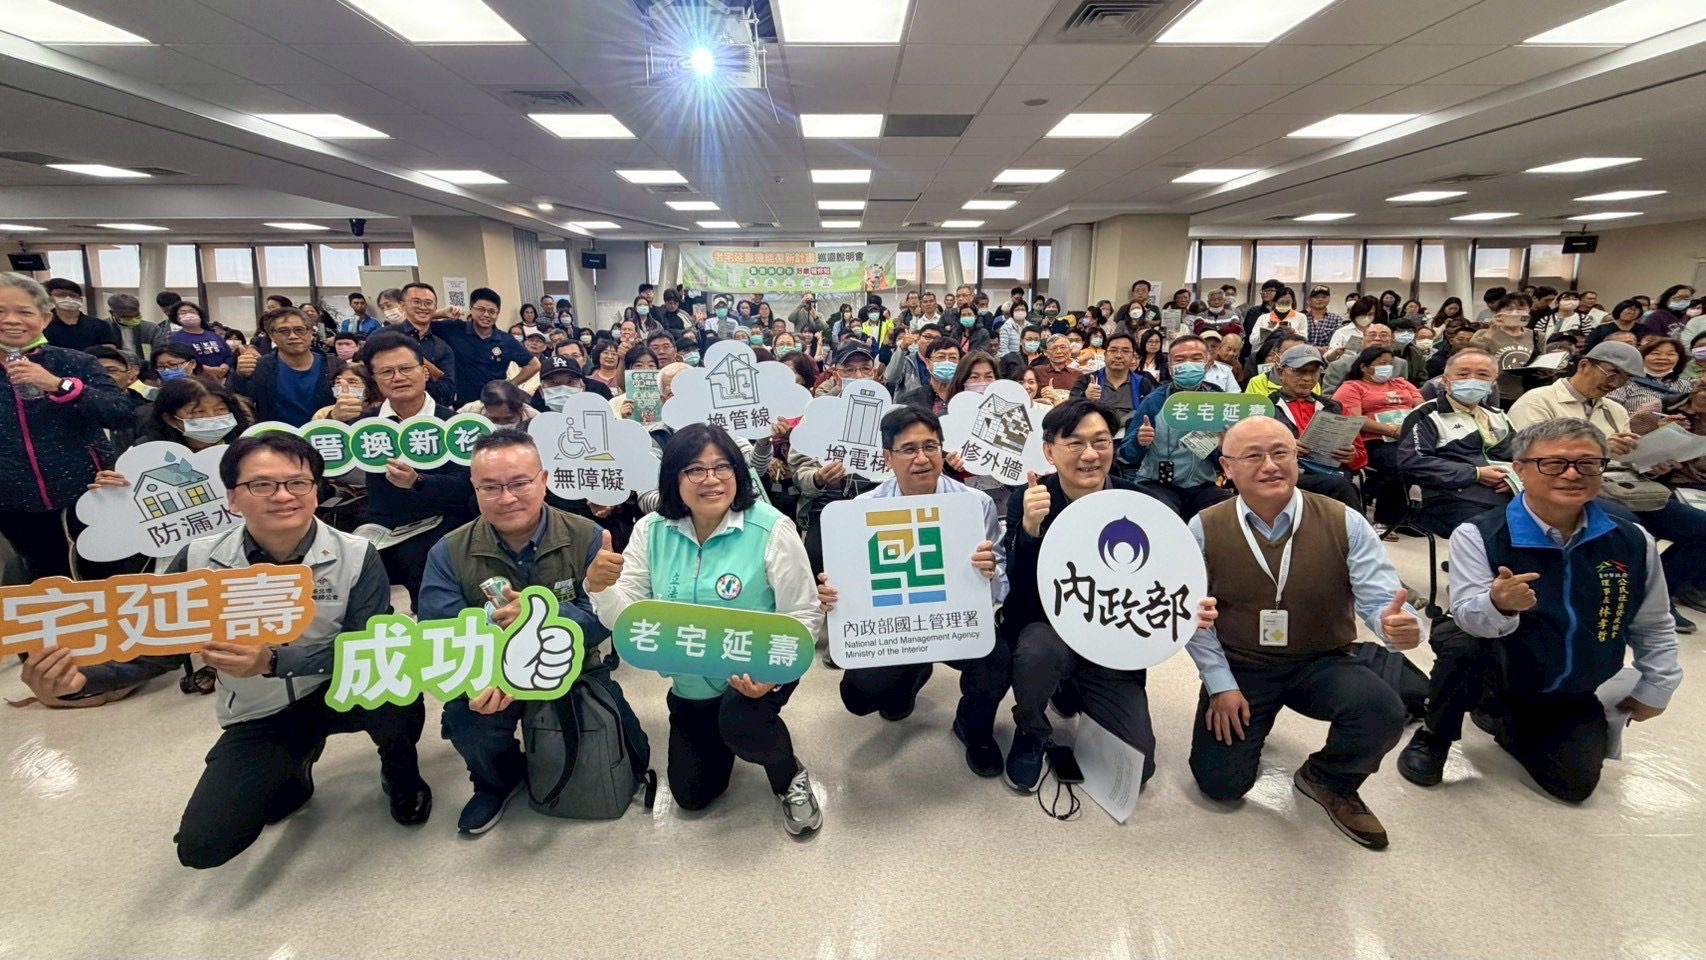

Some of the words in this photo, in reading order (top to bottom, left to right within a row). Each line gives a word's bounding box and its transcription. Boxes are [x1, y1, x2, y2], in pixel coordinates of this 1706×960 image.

[553, 357, 567, 367] LA
[553, 467, 625, 491] 無障礙
[960, 440, 1024, 482] 修外牆
[147, 504, 243, 548] 防漏水
[2, 572, 305, 657] 宅延壽
[1053, 561, 1192, 642] 內政部
[629, 619, 800, 667] 老宅延壽
[843, 610, 979, 639] 內政部國土管理署
[844, 638, 877, 649] National
[878, 636, 898, 647] Land
[900, 633, 950, 645] Management
[951, 631, 981, 641] Agency
[334, 616, 495, 704] 成功
[845, 649, 876, 659] Ministry
[877, 647, 885, 656] of
[887, 646, 899, 655] the
[901, 644, 929, 654] Interior
